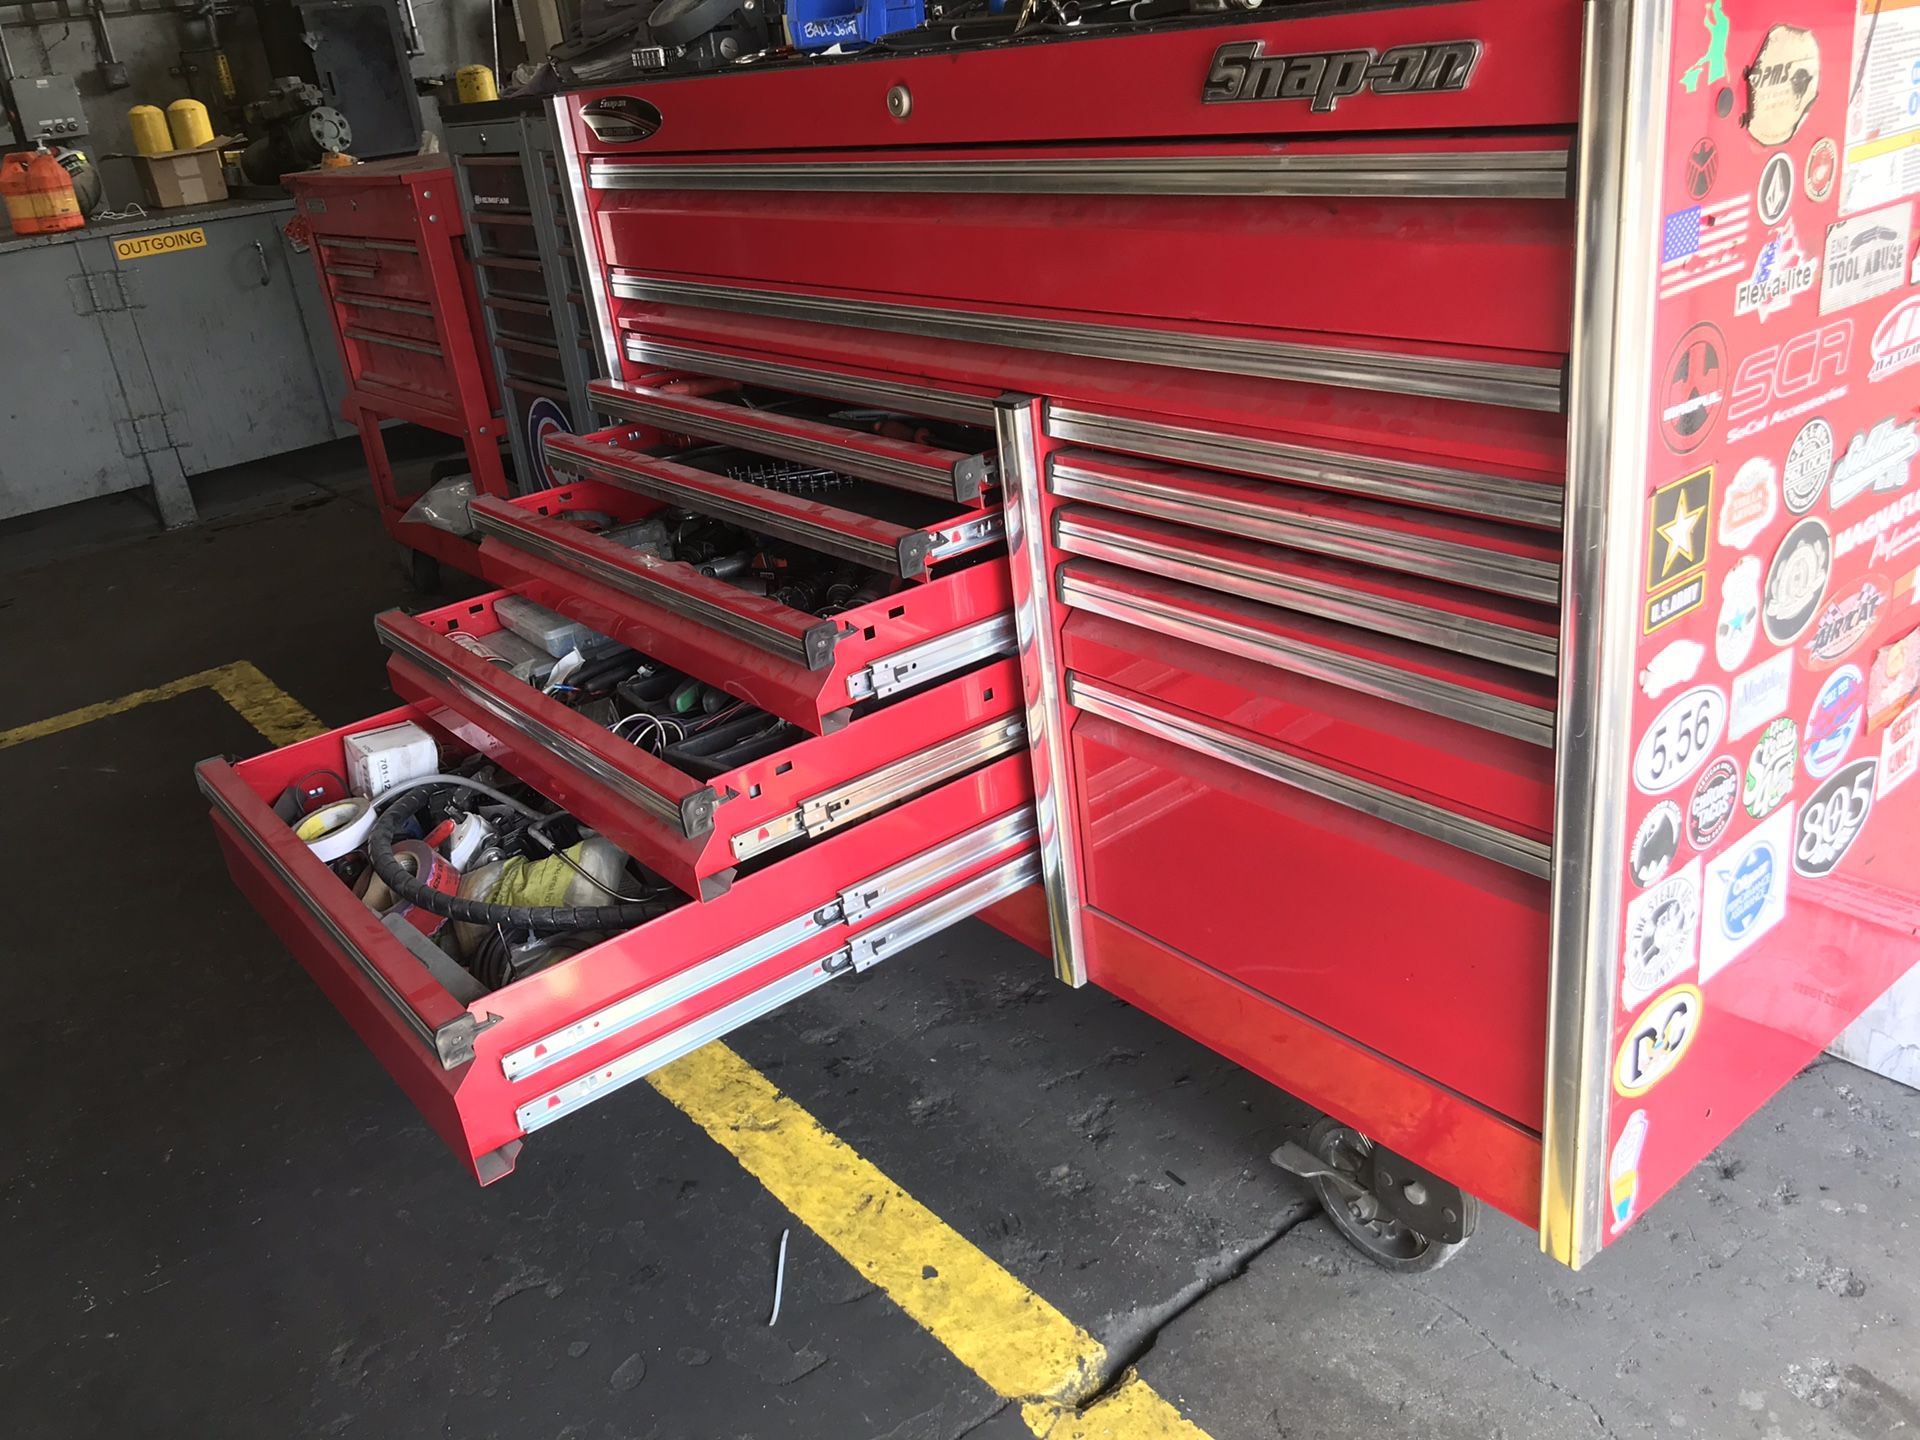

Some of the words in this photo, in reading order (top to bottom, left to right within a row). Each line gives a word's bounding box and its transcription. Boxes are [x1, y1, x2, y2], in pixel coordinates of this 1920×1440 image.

[803, 22, 832, 38] BALL
[1202, 39, 1483, 113] Snap-on
[118, 231, 203, 256] OUTGOING
[1829, 256, 1860, 289] TOOL
[1863, 243, 1905, 279] ABUSE
[1830, 235, 1850, 254] END
[1738, 264, 1812, 311] Flex-a-lite
[1727, 319, 1854, 421] SCA
[1726, 416, 1767, 445] SoCal
[1650, 699, 1711, 780] 5.56
[1798, 766, 1874, 862] 805
